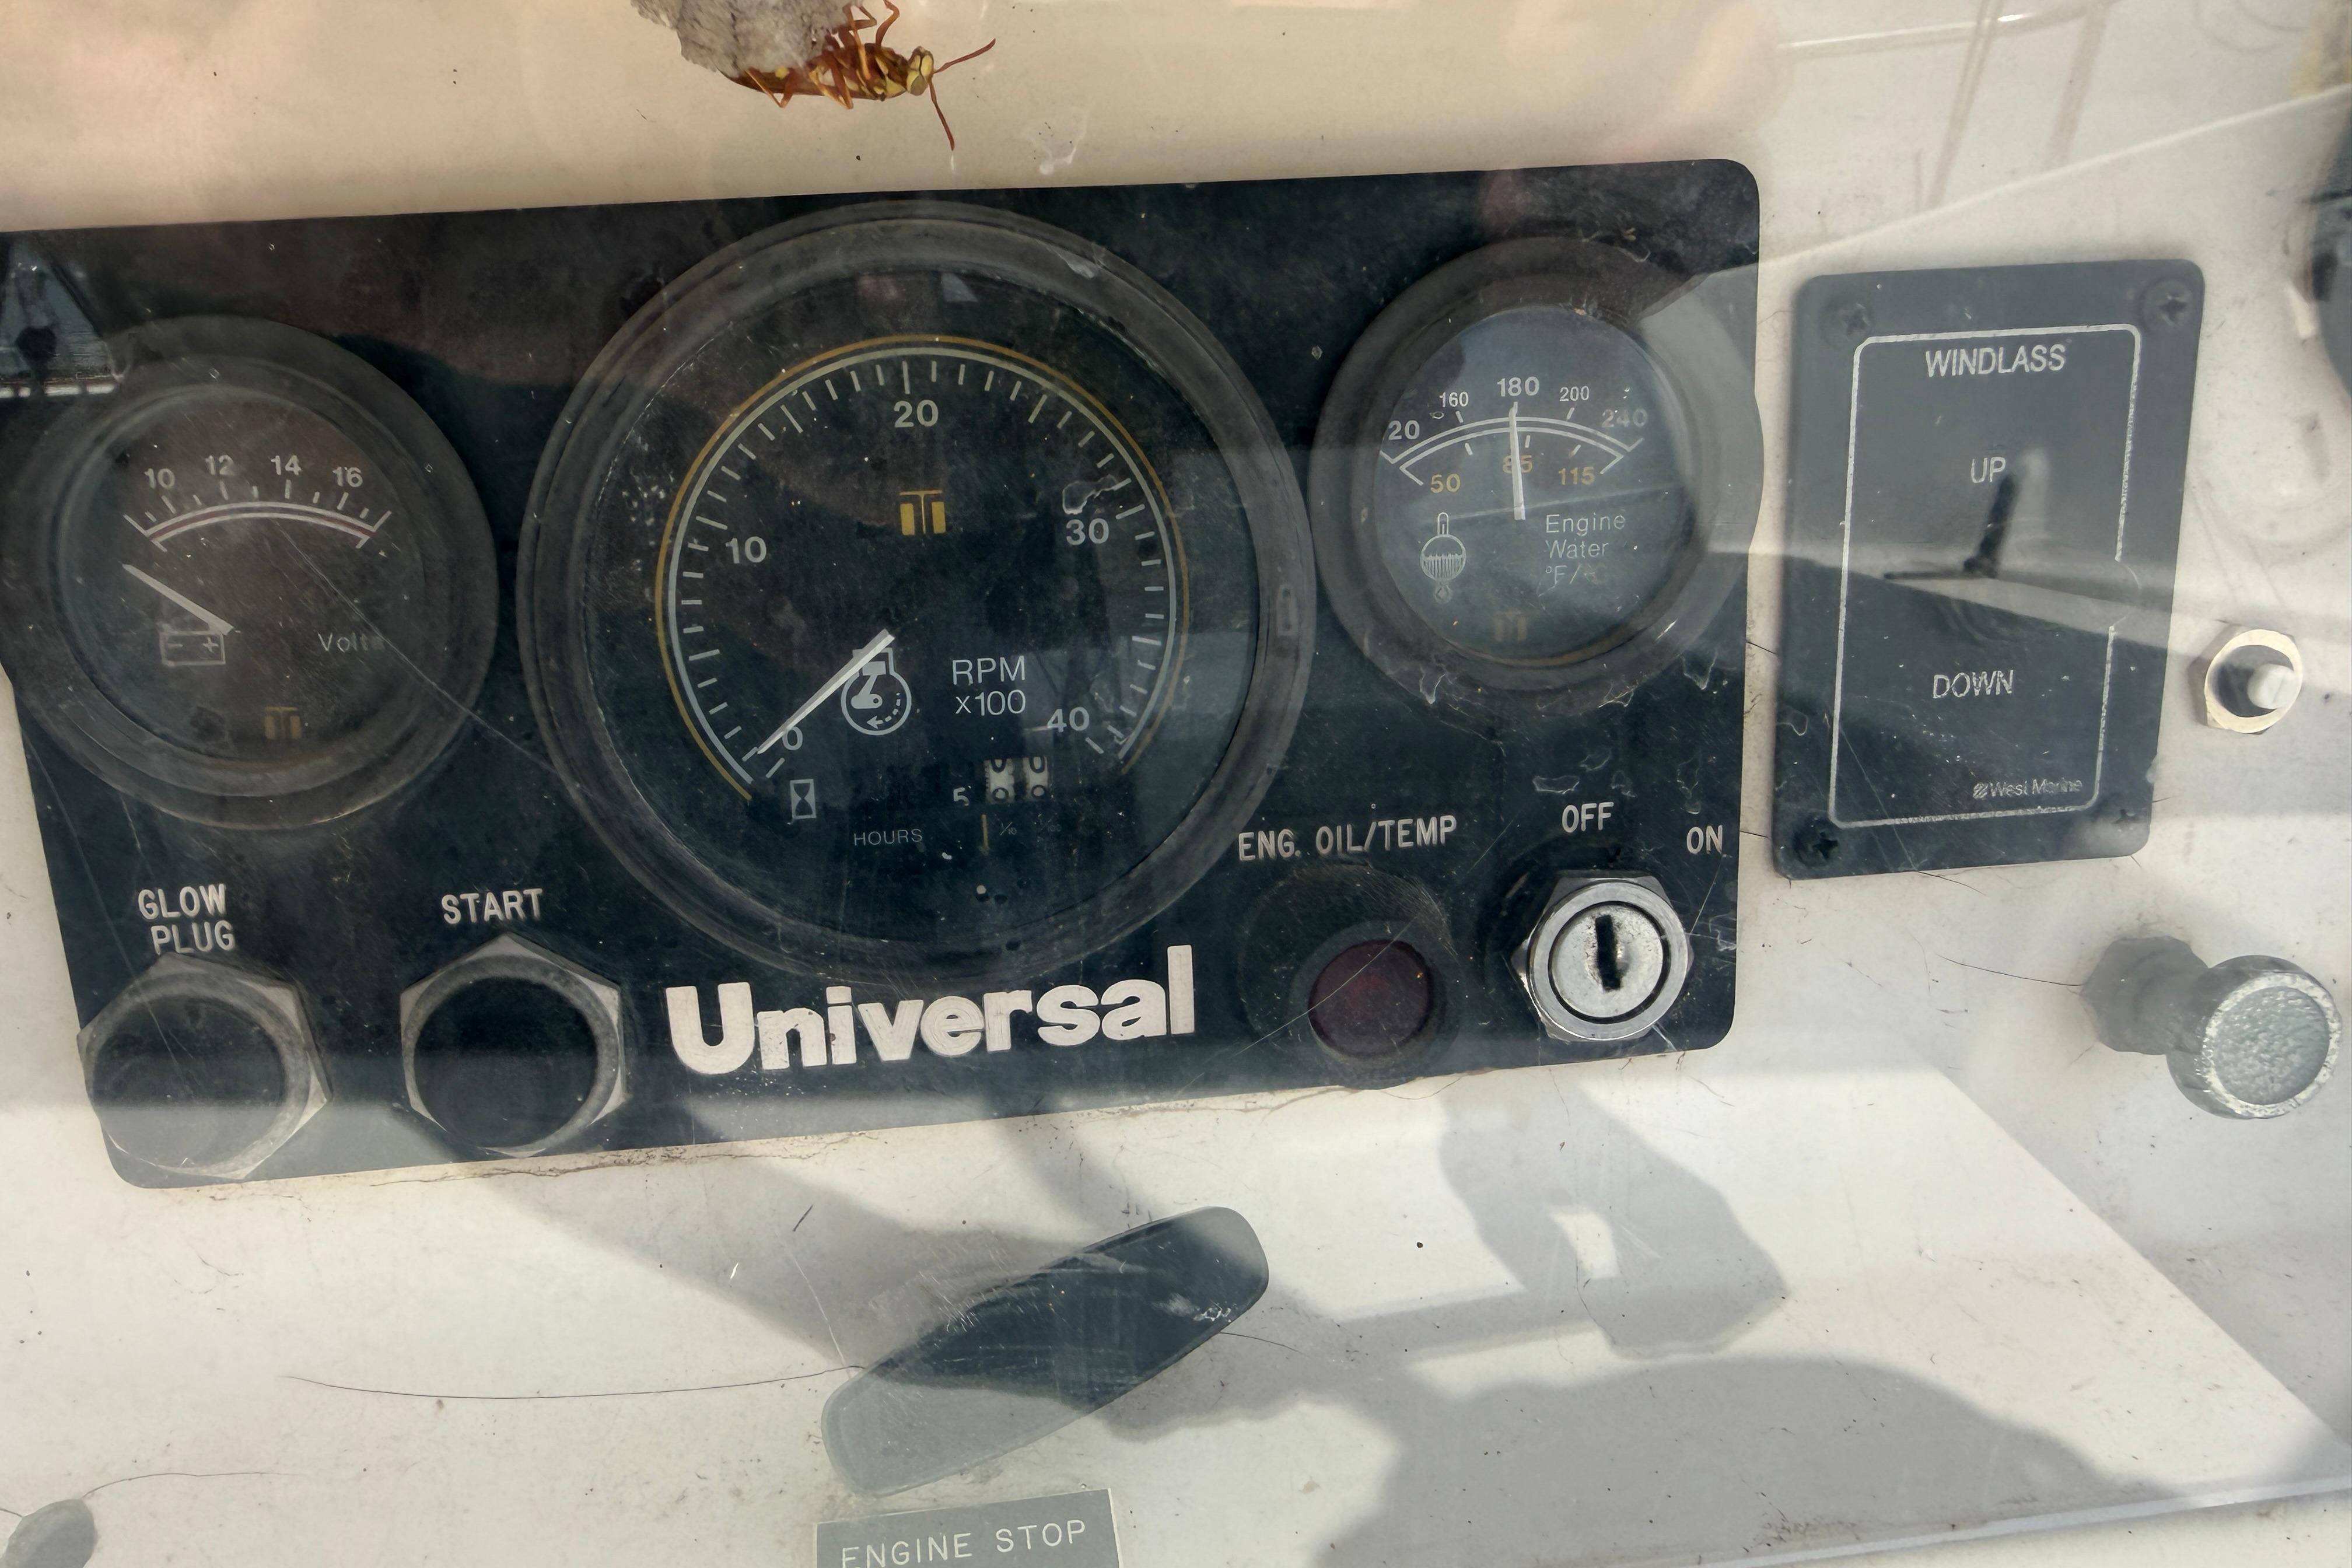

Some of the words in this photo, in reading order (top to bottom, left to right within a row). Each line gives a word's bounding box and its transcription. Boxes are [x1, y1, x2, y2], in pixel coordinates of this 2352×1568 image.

[1925, 344, 2067, 378] WINDLASS
[1439, 391, 1469, 408] 160
[1497, 376, 1540, 397] 180
[1559, 386, 1590, 402] 200
[894, 400, 940, 428] 20
[1601, 408, 1648, 428] 240
[205, 454, 235, 476] 12
[270, 454, 302, 476] 14
[331, 467, 364, 488] 16
[1558, 466, 1597, 486] 115
[1971, 456, 2007, 484] UP
[144, 468, 176, 489] 10
[1430, 473, 1461, 494] 50
[1065, 517, 1110, 546] 30
[1546, 512, 1626, 537] Engine
[725, 536, 768, 564] 10
[1545, 539, 1609, 559] Water
[317, 632, 386, 653] Volt
[951, 655, 1027, 685] RPM
[1932, 669, 2014, 699] DOWN
[1046, 706, 1090, 733] 40
[782, 726, 803, 751] 0
[1990, 780, 2028, 797] West
[1562, 802, 1615, 834] OFF
[853, 828, 924, 846] HOURS
[1238, 830, 1301, 862] ENG.
[1315, 815, 1458, 854] OIL/TEMP
[1686, 824, 1724, 855] ON
[138, 883, 227, 921] GLOW
[441, 888, 543, 925] START
[150, 920, 233, 955] PLUG
[665, 944, 1195, 1075] Universal
[842, 1532, 972, 1568] ENGINE
[996, 1519, 1086, 1553] STOP
